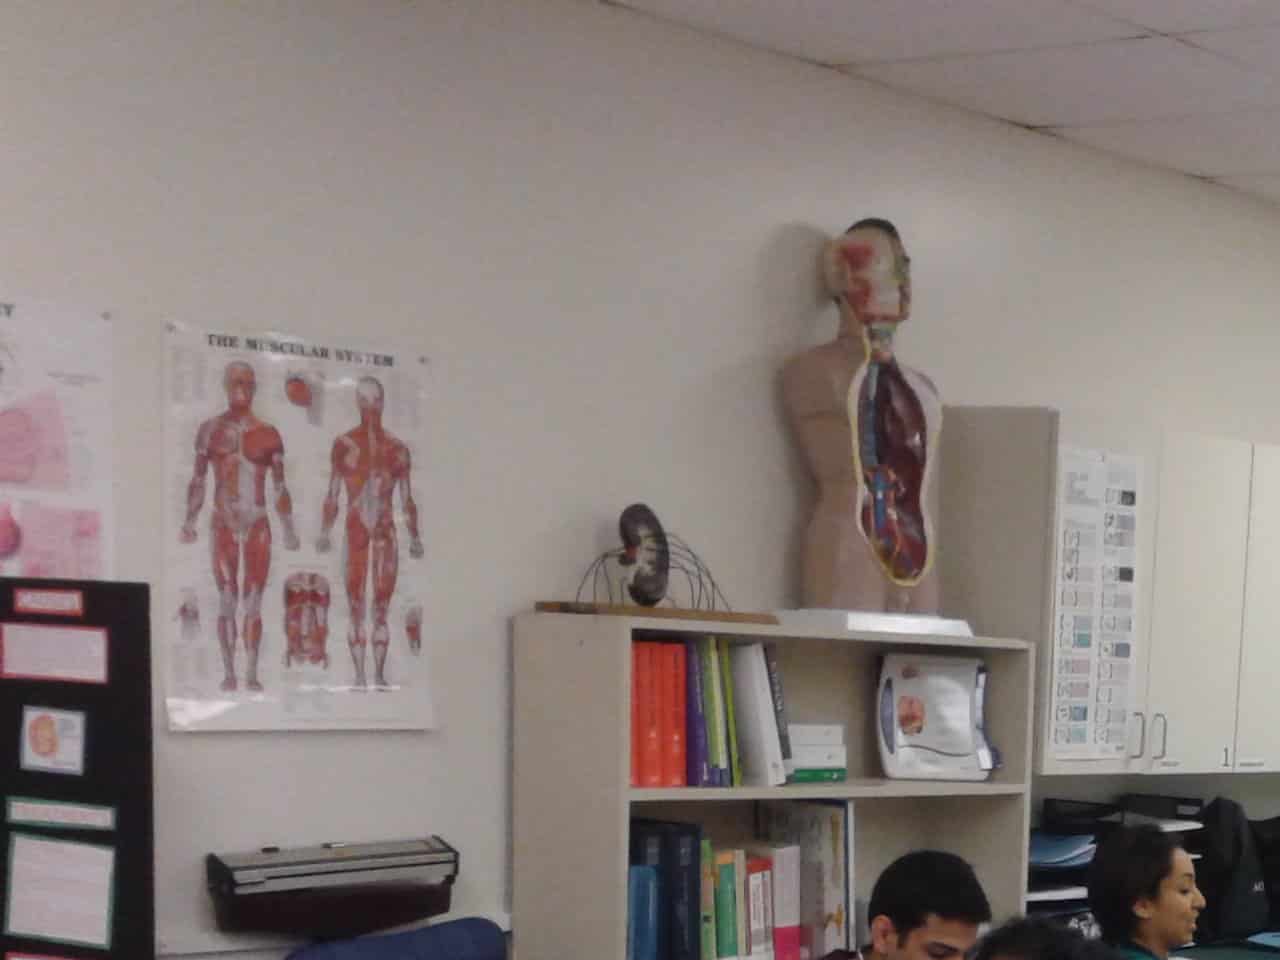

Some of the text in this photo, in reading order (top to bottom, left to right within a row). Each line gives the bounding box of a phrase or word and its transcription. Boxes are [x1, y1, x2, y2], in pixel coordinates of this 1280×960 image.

[207, 333, 395, 367] THE MUSCULAR SYSTEM
[1222, 746, 1231, 767] 1
